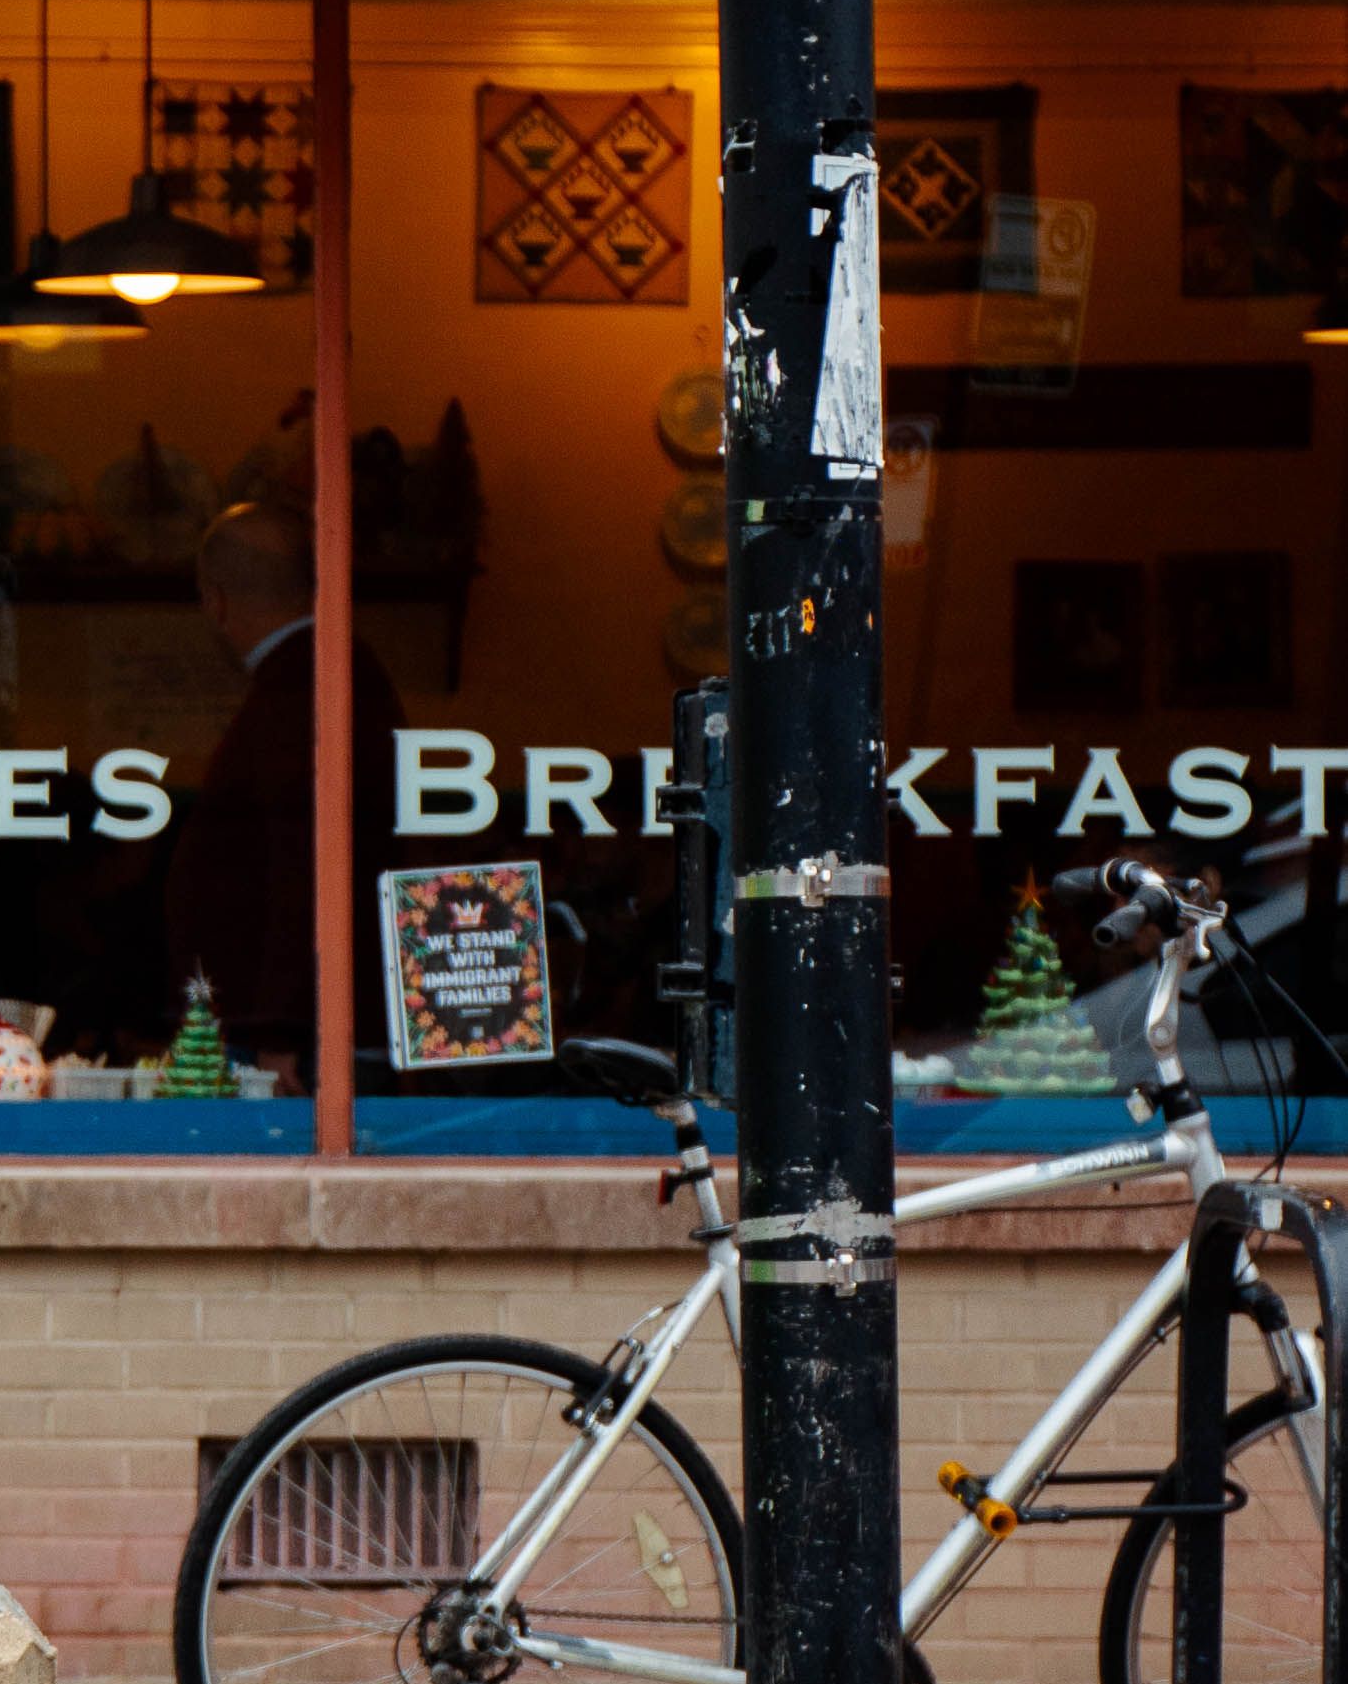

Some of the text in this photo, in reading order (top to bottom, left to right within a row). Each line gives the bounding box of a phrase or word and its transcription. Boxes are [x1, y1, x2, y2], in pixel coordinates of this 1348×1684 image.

[393, 729, 1348, 839] BRKFAST
[426, 929, 516, 950] WE STAND
[450, 950, 495, 967] WITH
[422, 966, 522, 989] IMMIGRANT
[437, 986, 511, 1006] FAMILIES
